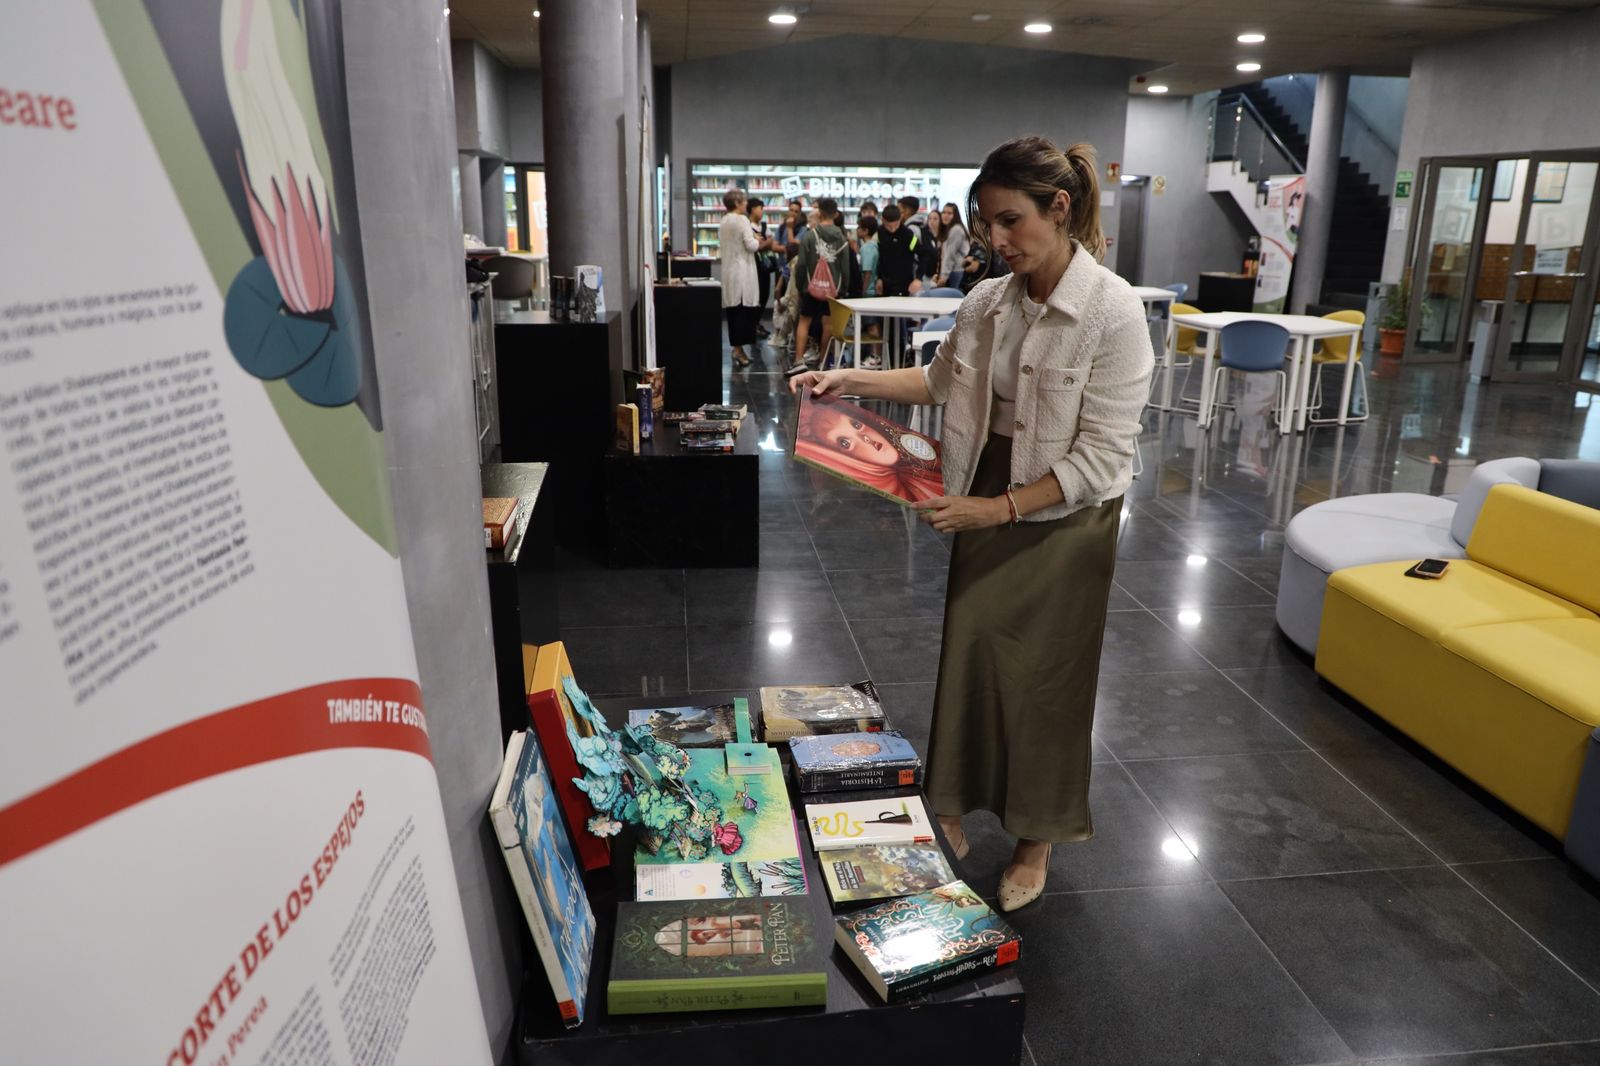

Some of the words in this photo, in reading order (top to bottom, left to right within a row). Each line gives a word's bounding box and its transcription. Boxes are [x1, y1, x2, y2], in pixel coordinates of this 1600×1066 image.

[327, 693, 382, 724] TAMBIÉN
[385, 700, 400, 724] TE
[840, 769, 884, 779] INTERMINABLE
[840, 777, 873, 787] HISTORIA
[239, 922, 275, 981] DE
[272, 873, 314, 939] LOS
[312, 788, 366, 890] ESPEJOS
[767, 902, 785, 928] PAN
[770, 928, 790, 966] PETER
[696, 994, 730, 1006] PETER
[227, 993, 270, 1058] Perea
